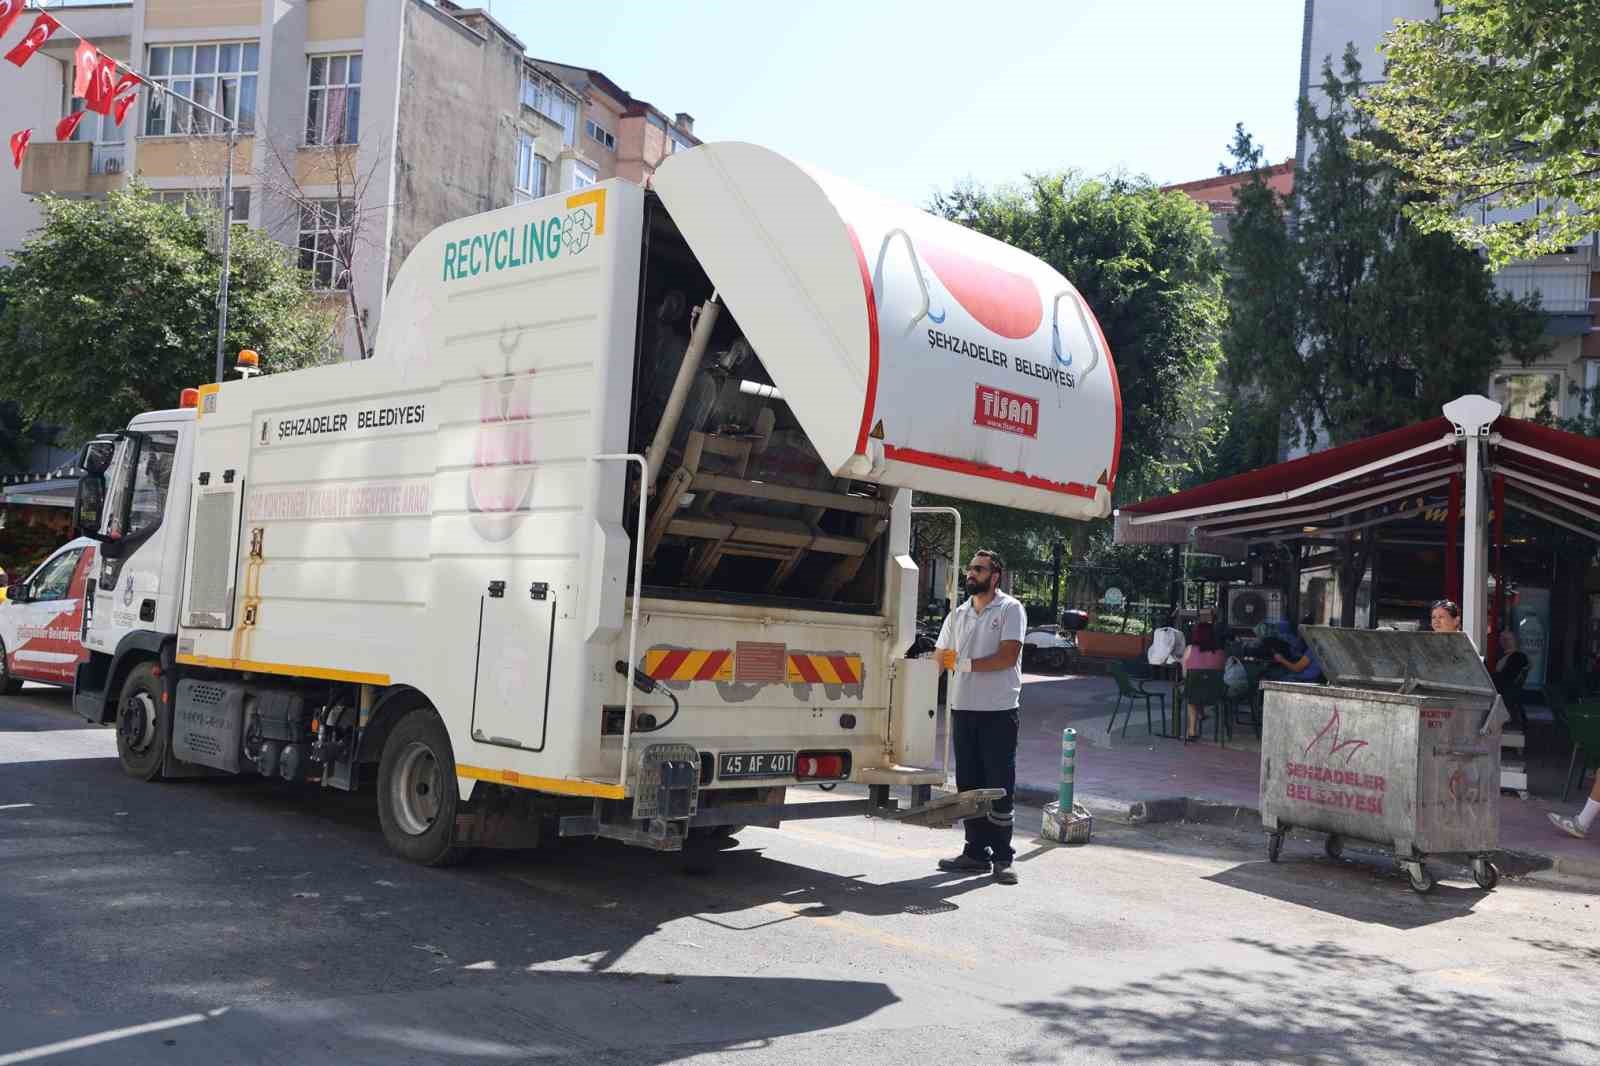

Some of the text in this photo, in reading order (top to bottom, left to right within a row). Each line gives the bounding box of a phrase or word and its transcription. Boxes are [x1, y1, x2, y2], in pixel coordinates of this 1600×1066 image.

[442, 216, 562, 282] RECYCLING
[927, 329, 1008, 369] ŞEHZADELER
[278, 413, 348, 441] ŞEHZADELER
[726, 754, 791, 773] 45 AF 401
